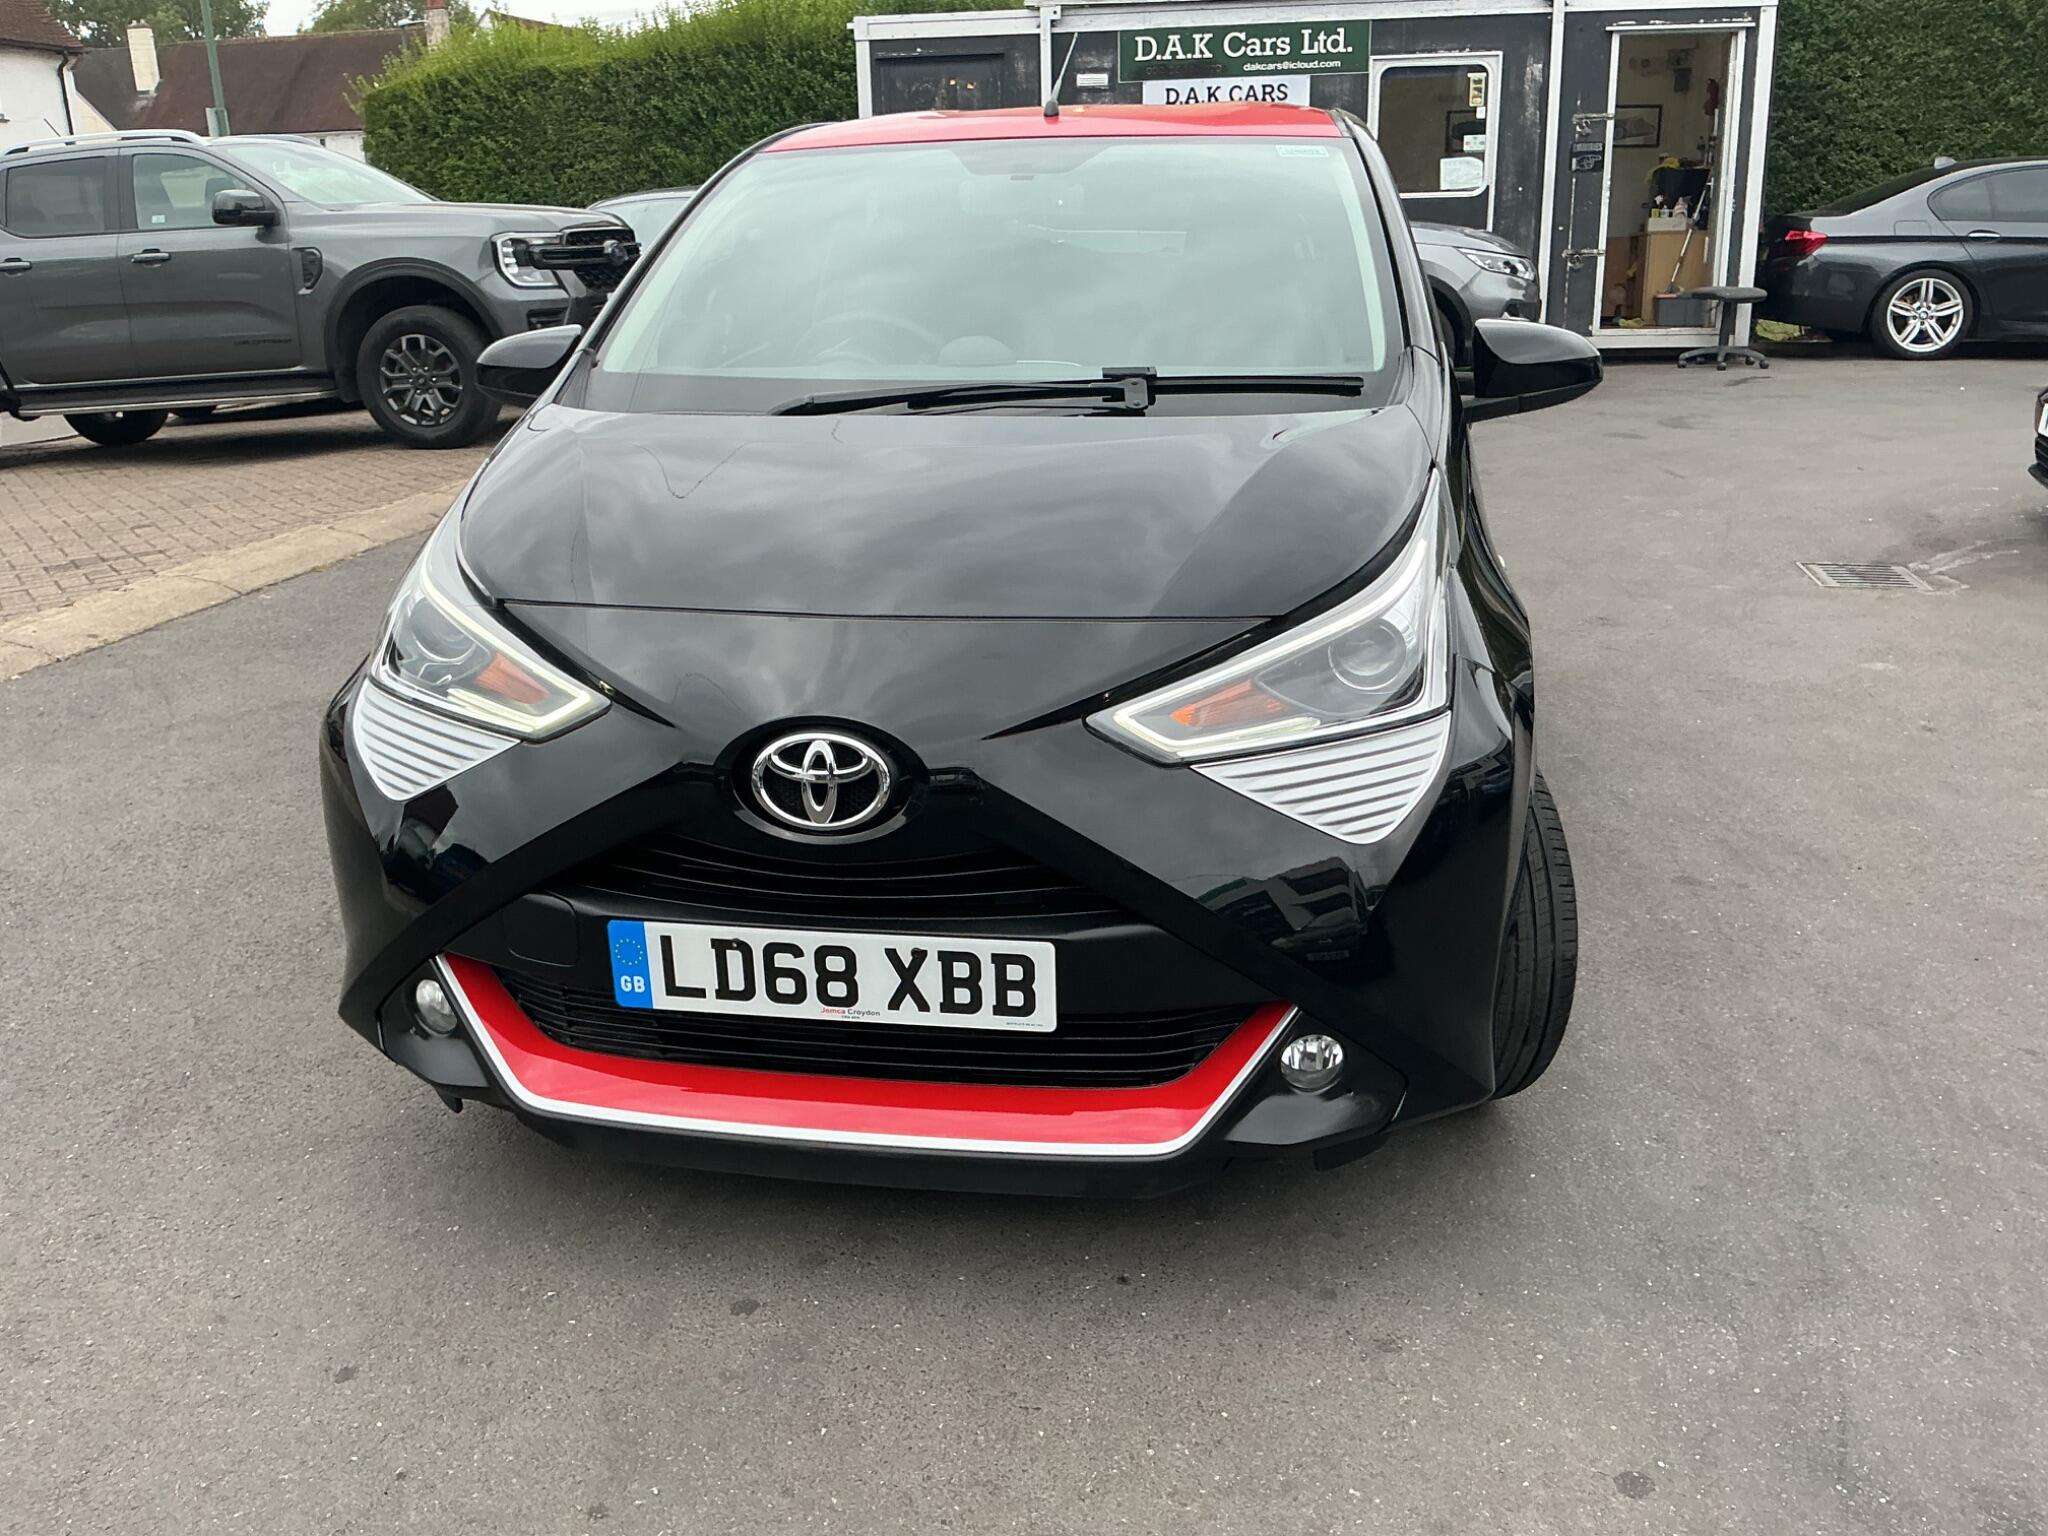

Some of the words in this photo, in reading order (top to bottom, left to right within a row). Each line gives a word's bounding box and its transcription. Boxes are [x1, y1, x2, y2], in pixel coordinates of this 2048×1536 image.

[1134, 33, 1214, 61] D.A.K
[1223, 32, 1291, 58] Cars
[1300, 27, 1353, 55] Ltd.
[1243, 59, 1341, 72] dakcars@icloud.com
[1228, 83, 1289, 102] CARS
[620, 975, 646, 993] GB
[659, 935, 860, 1008] LD68
[884, 947, 1037, 1018] XBB
[847, 1008, 881, 1017] Croydon
